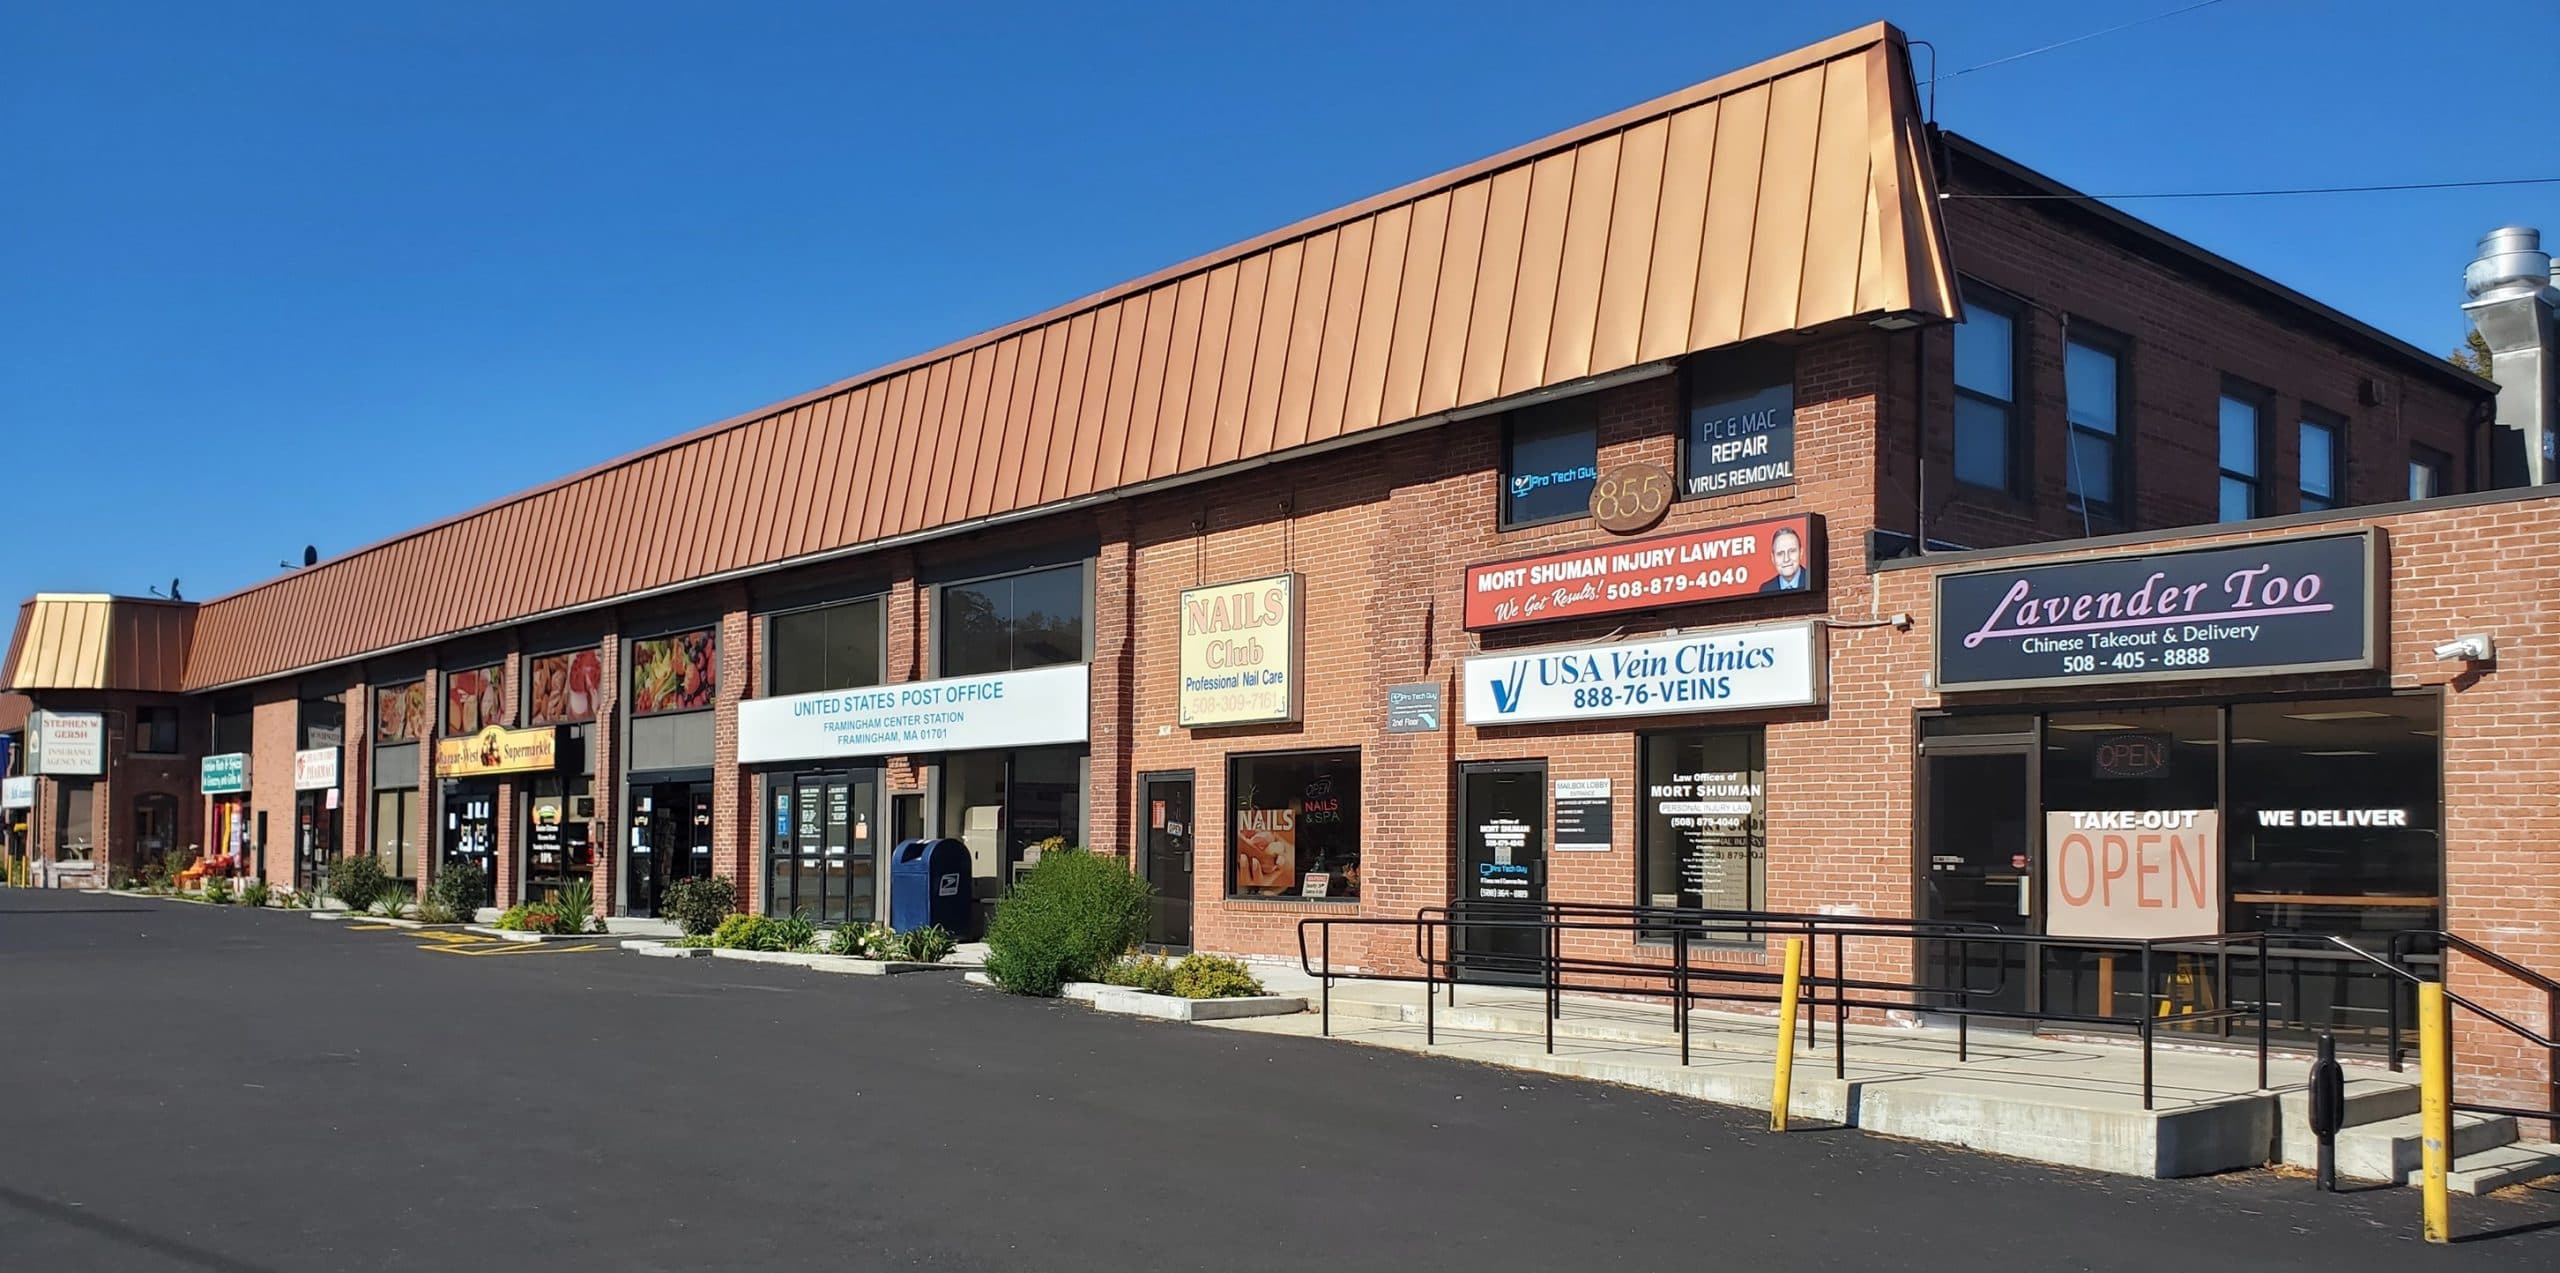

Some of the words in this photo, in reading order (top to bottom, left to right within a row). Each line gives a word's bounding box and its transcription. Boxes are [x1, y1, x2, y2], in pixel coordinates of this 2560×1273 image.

[1703, 420, 1723, 442] PC
[1727, 418, 1736, 434] &
[1741, 408, 1777, 433] MAC
[1711, 435, 1768, 465] REPAIR
[1532, 474, 1549, 488] Pro
[1551, 470, 1576, 485] Tech
[1688, 473, 1727, 495] VIRUS
[1729, 462, 1793, 487] REMOVAL
[1597, 475, 1663, 521] 855
[1478, 568, 1526, 593] MORT
[1530, 556, 1607, 585] SHUMAN
[1612, 548, 1676, 574] INJURY
[1680, 535, 1756, 563] LAWYER
[1495, 601, 1519, 622] We
[1524, 594, 1546, 617] Get
[1552, 580, 1603, 608] Results!
[1606, 566, 1748, 601] 508-879-4040
[1187, 588, 1284, 635] NAILS
[1963, 573, 2208, 649] Lavender
[2223, 563, 2322, 609] Too
[2022, 636, 2084, 654] Chinese
[2088, 629, 2157, 651] Takeout
[2164, 627, 2178, 644] &
[2183, 623, 2260, 646] Delivery
[1206, 637, 1264, 669] Club
[1538, 655, 1602, 686] USA
[1611, 648, 1668, 680] Vein
[1675, 640, 1775, 674] Clinics
[2063, 655, 2095, 673] 508
[2112, 653, 2145, 669] 405
[2164, 648, 2210, 667] 8888
[1186, 673, 1239, 692] Professional
[1243, 670, 1259, 687] Nail
[1262, 669, 1284, 685] Care
[794, 697, 840, 717] UNITED
[844, 692, 895, 711] STATES
[902, 688, 940, 706] POST
[946, 682, 1004, 702] OFFICE
[1574, 677, 1731, 709] 888-76-VEINS
[43, 719, 88, 729] STEPHEN
[823, 717, 881, 733] FRAMINGHAM
[884, 715, 921, 727] CENTER
[923, 711, 964, 725] STATION
[1392, 718, 1403, 727] 2nd
[1405, 717, 1419, 726] Floor
[54, 730, 88, 739] GERSH
[838, 731, 900, 745] FRAMINGHAM,
[903, 730, 918, 741] MA
[920, 728, 947, 740] 01701
[504, 740, 552, 764] Supermarket
[2100, 744, 2162, 767] OPEN
[1557, 782, 1585, 790] MAILBOX
[1587, 781, 1608, 790] LOBBY
[1673, 774, 1692, 782] Law
[1694, 773, 1725, 782] Offices
[1727, 772, 1737, 781] of
[1651, 785, 1692, 797] MORT
[1696, 784, 1761, 797] SHUMAN
[1305, 799, 1338, 812] NAILS
[1314, 811, 1341, 823] SPA
[1239, 809, 1294, 831] NAILS
[2069, 811, 2199, 830] TAKE-OUT
[2257, 810, 2295, 827] WE
[2301, 809, 2406, 827] DELIVER
[2059, 833, 2206, 910] OPEN
